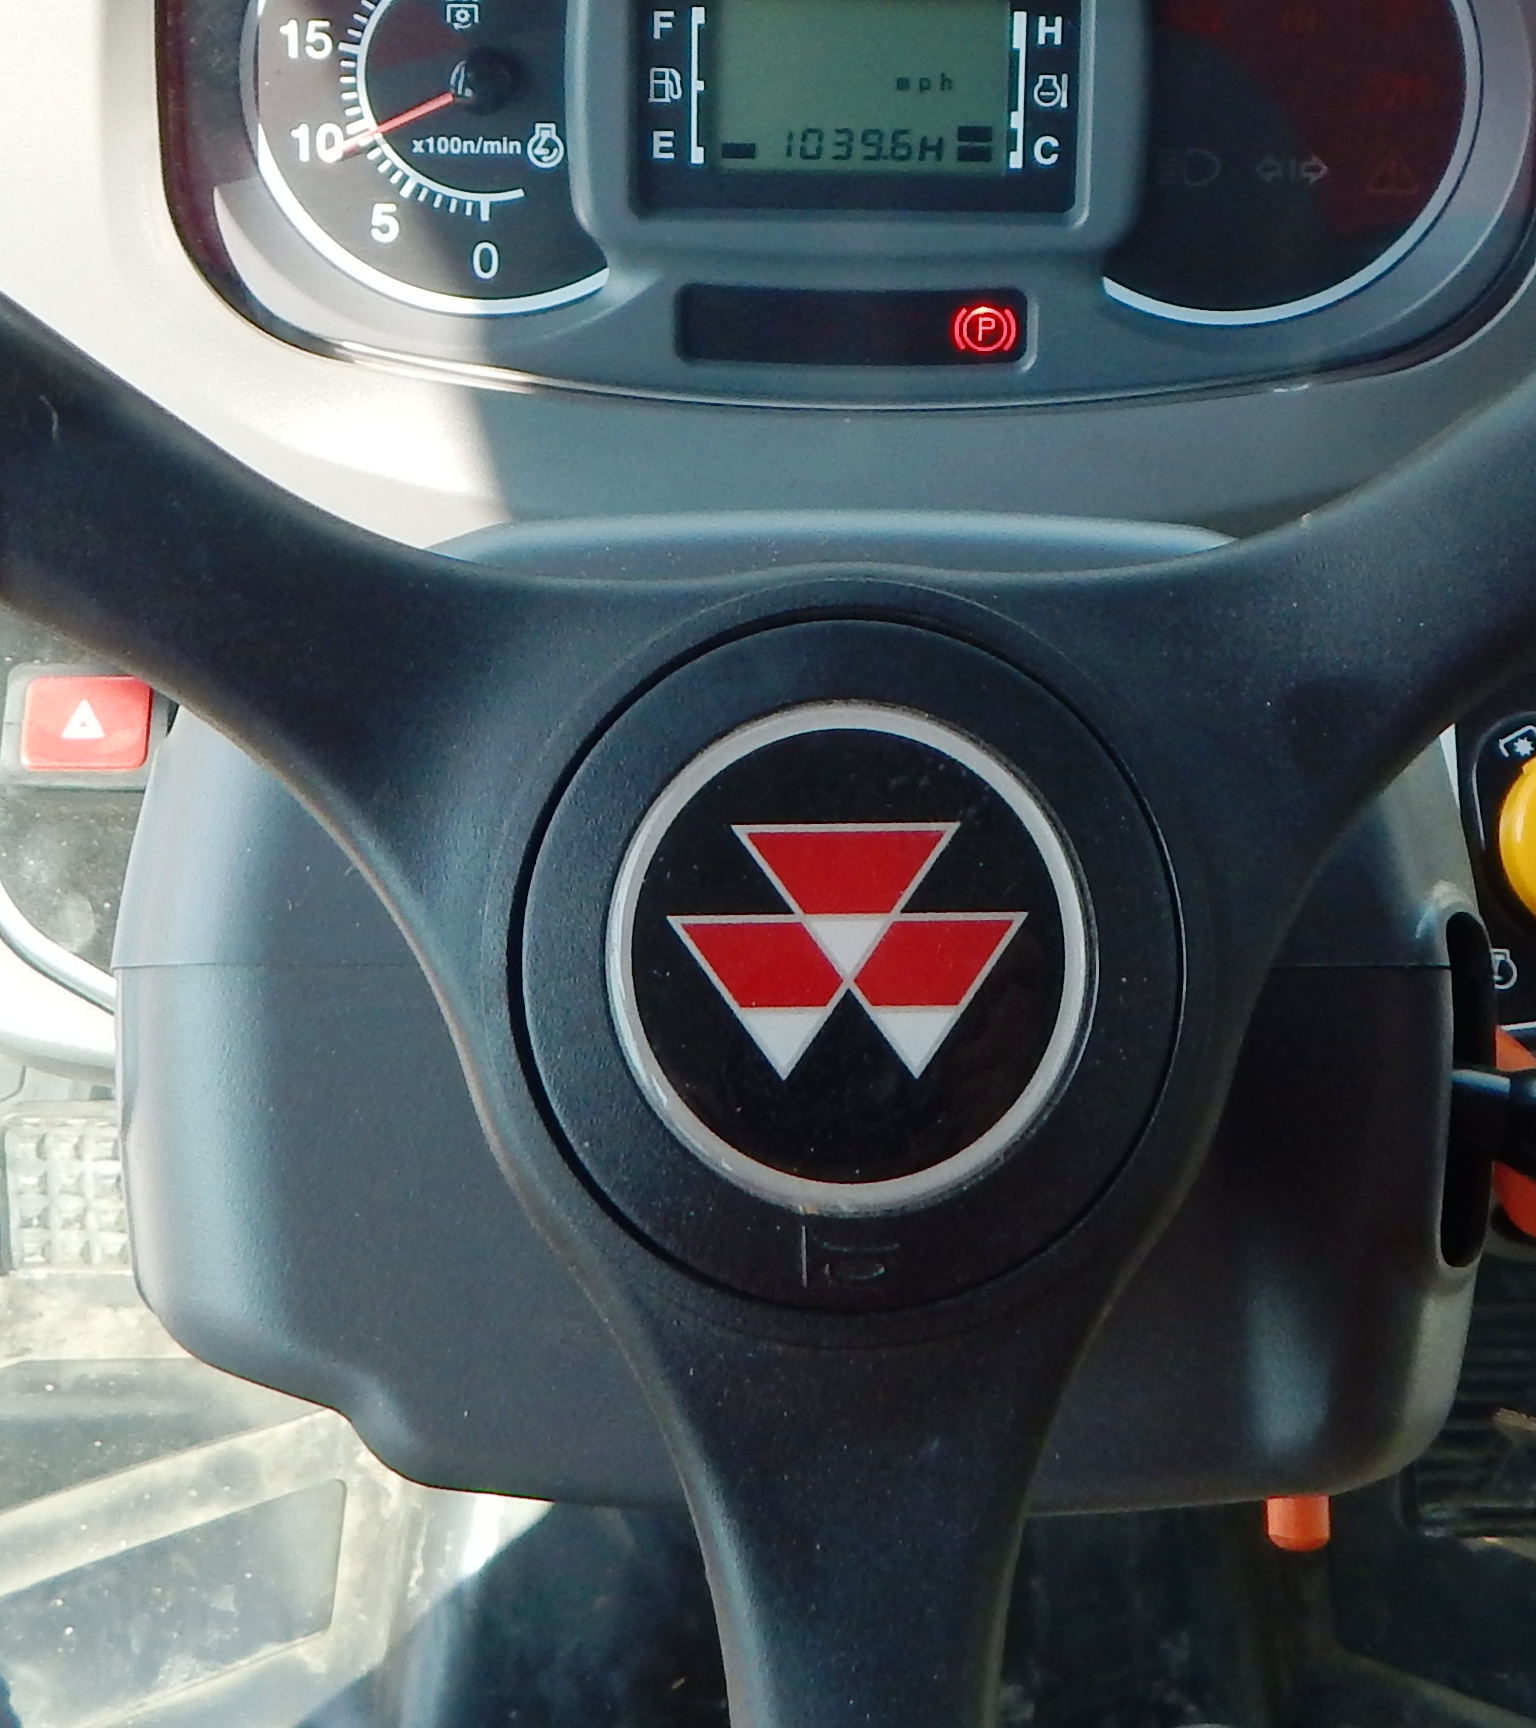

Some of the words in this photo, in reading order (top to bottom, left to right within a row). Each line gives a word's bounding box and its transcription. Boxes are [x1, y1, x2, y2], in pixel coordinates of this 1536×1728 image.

[279, 20, 332, 59] 15
[653, 11, 675, 40] F
[1037, 17, 1063, 45] H
[896, 73, 953, 93] mph
[291, 123, 344, 163] 10
[652, 131, 675, 159] E
[1034, 137, 1059, 165] C
[371, 203, 399, 243] 5
[473, 241, 499, 279] 0
